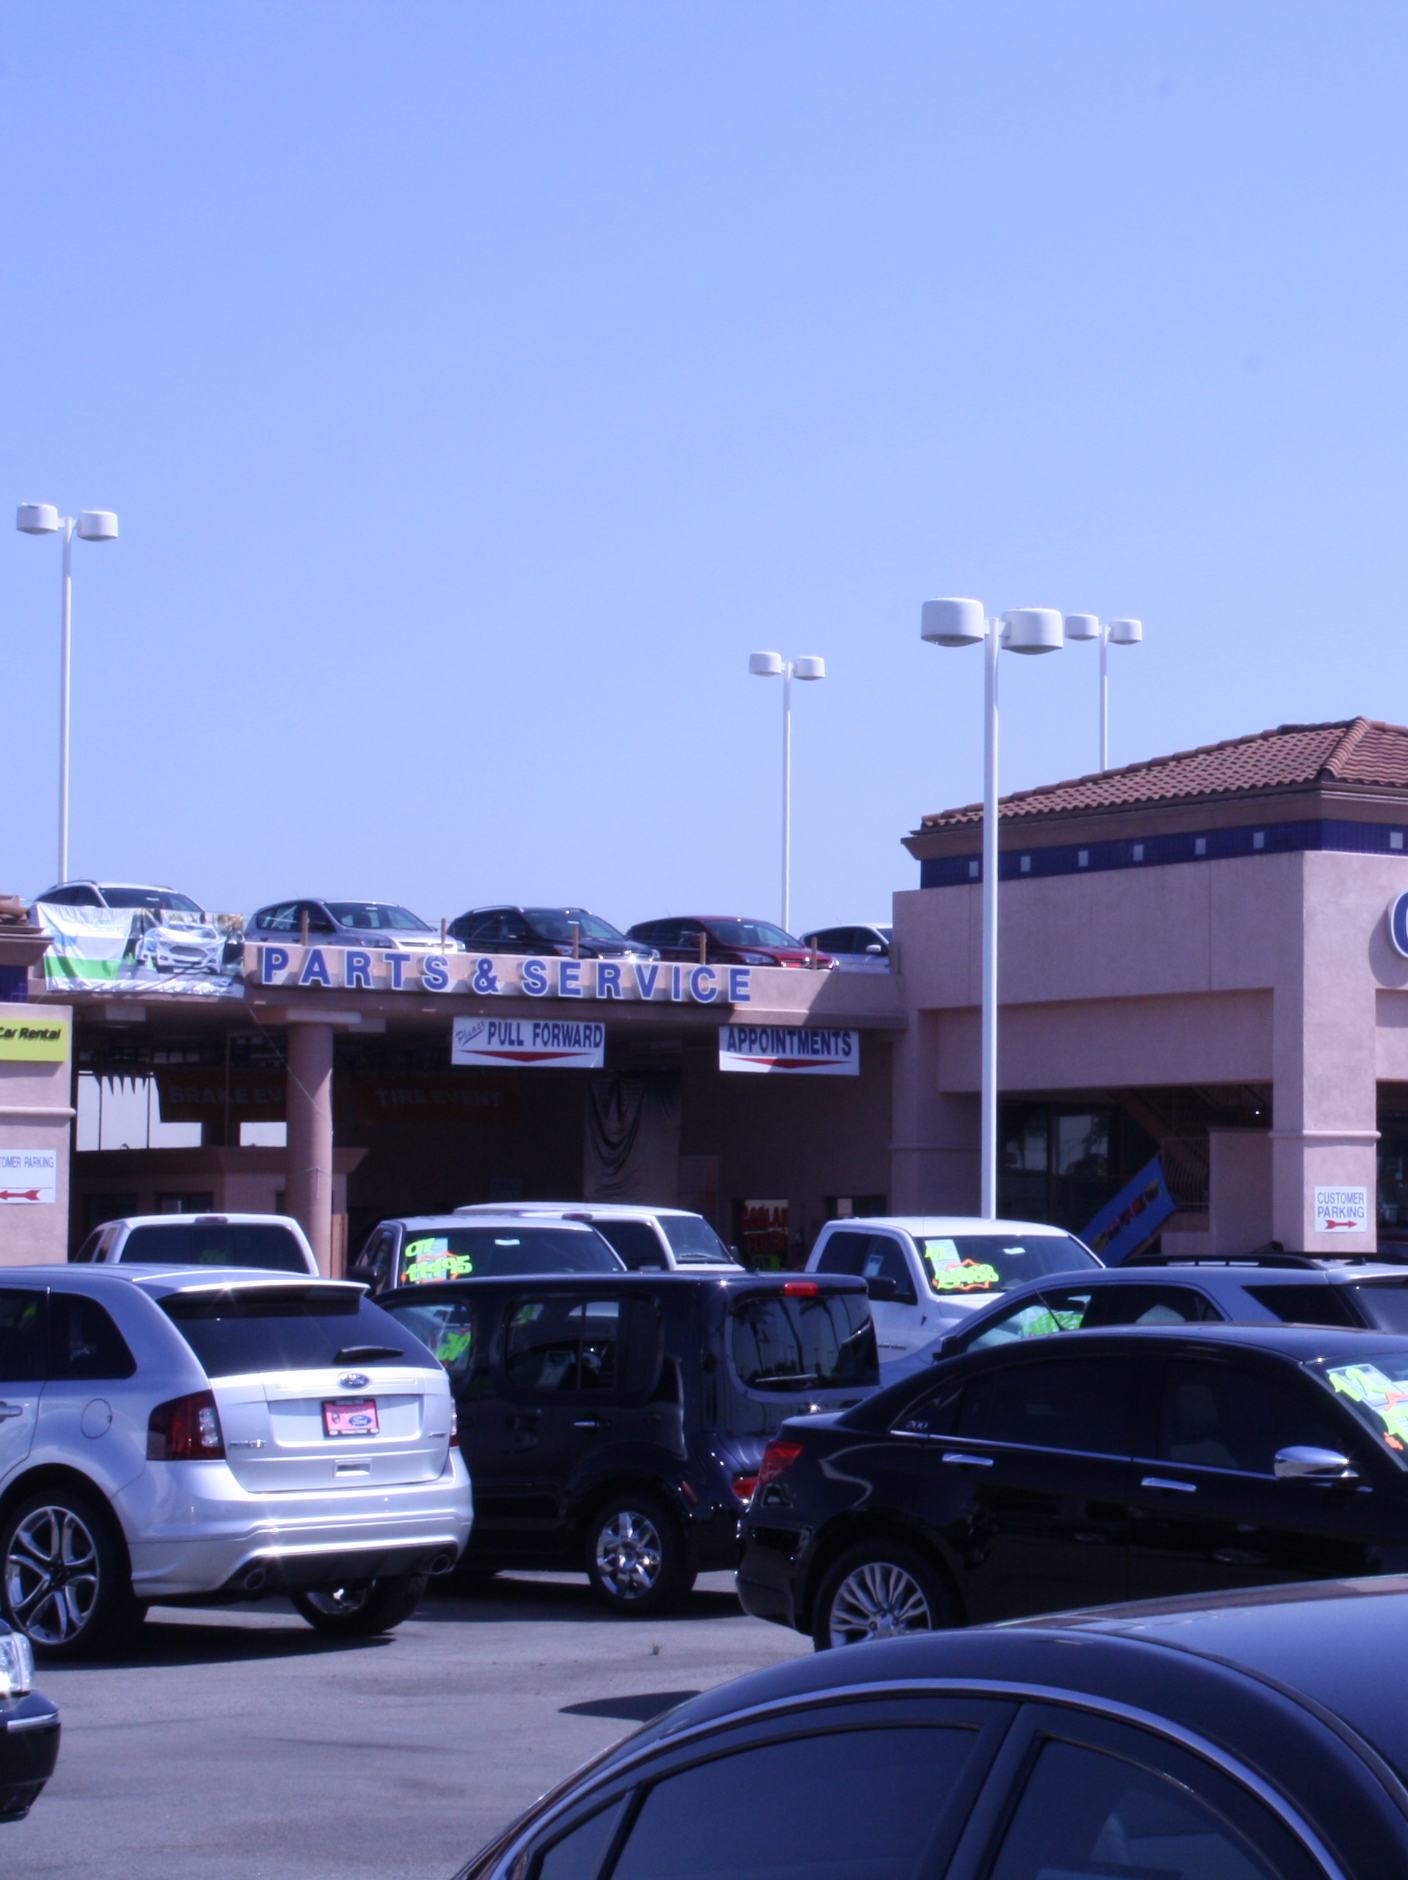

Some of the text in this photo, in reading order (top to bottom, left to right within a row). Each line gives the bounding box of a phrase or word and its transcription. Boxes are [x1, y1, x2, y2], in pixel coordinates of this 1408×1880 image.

[262, 946, 752, 1003] PARTS & SERVICE
[19, 1027, 62, 1041] Rental
[455, 1020, 603, 1048] Please PULL FORWARD
[727, 1026, 852, 1057] APPOINTMENTS
[24, 1156, 54, 1168] PARKING
[1317, 1192, 1364, 1205] CUSTOMER
[1317, 1205, 1365, 1218] PARKING
[405, 1237, 435, 1258] 07
[1328, 1366, 1391, 1402] 12
